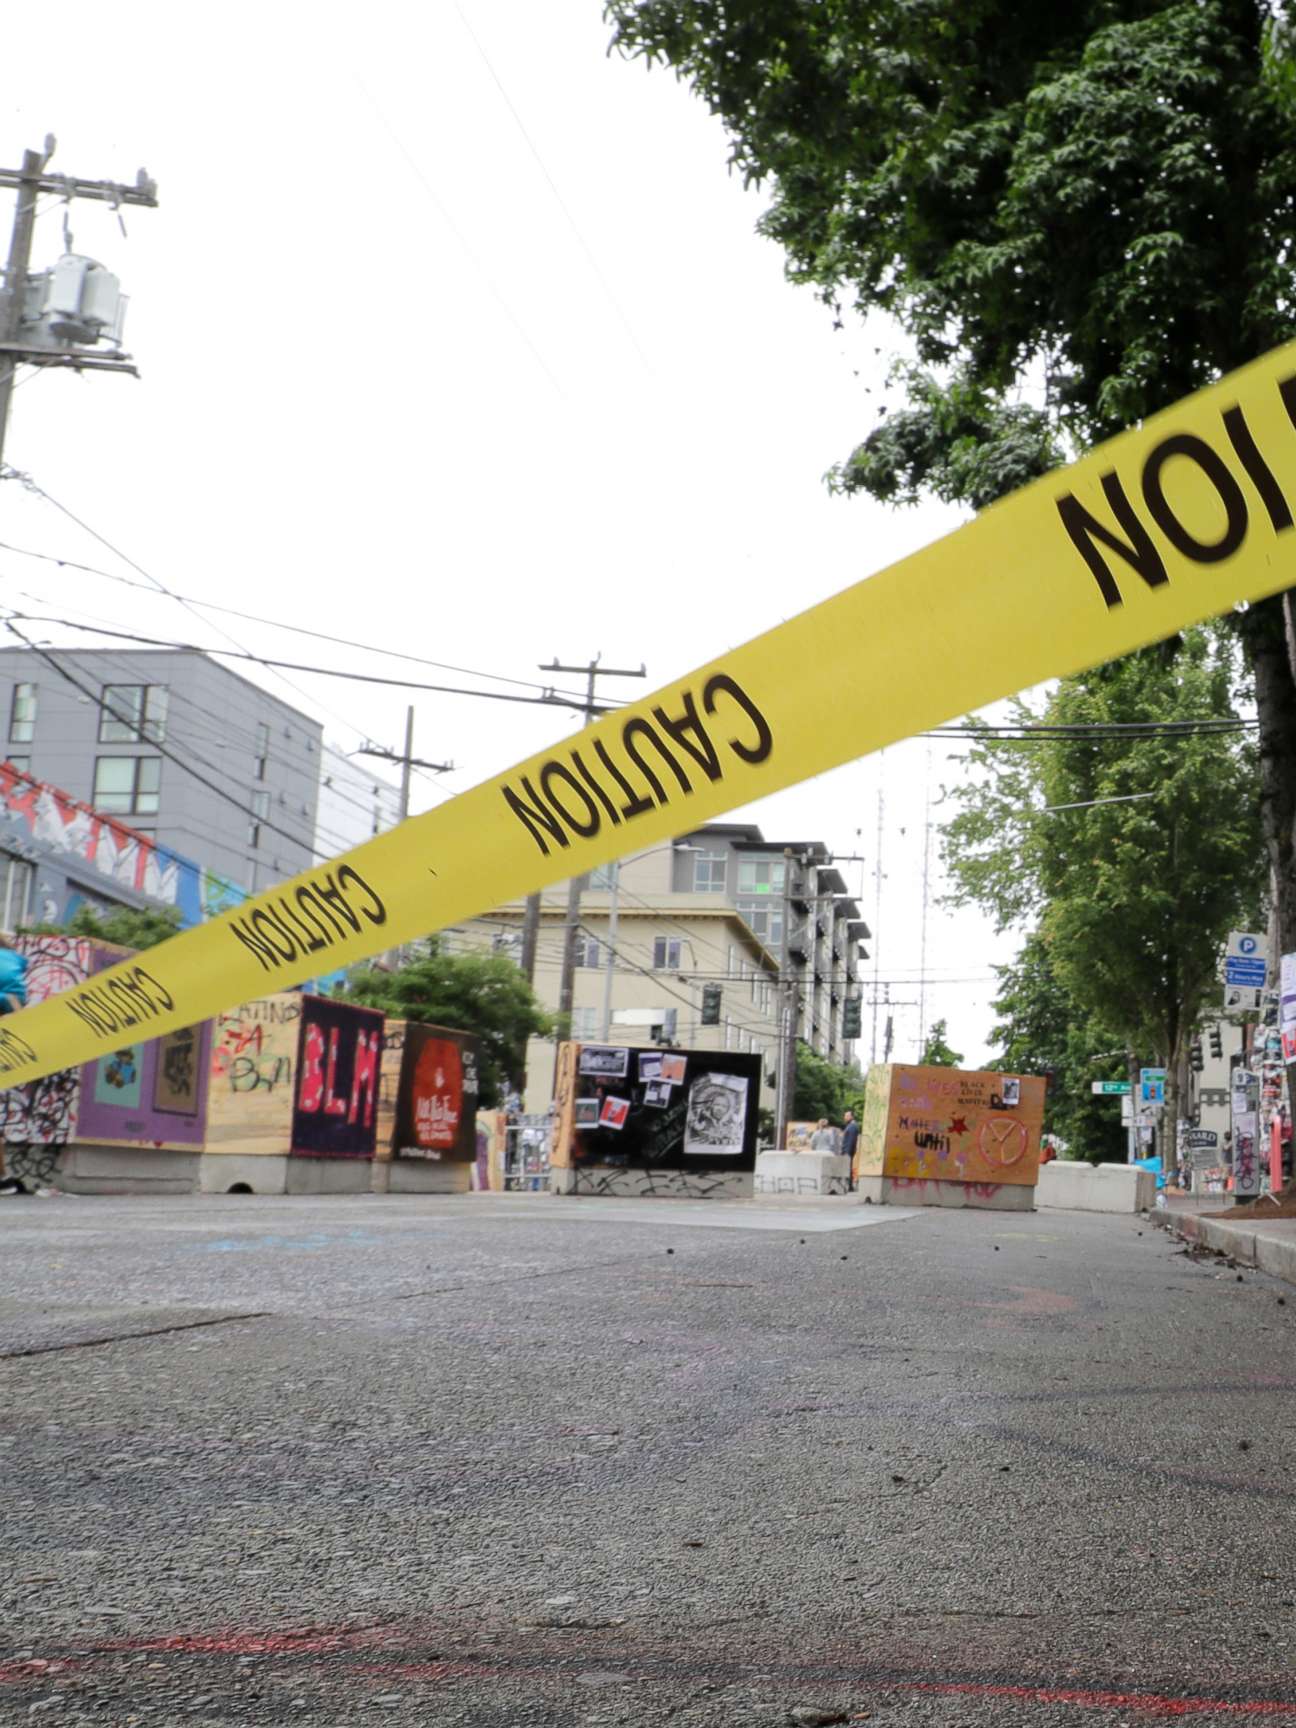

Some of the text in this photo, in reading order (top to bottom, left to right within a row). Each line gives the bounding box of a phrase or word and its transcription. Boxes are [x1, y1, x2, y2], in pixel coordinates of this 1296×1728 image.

[500, 673, 773, 857] CAUTION
[229, 864, 387, 971] CAUTION
[65, 966, 175, 1040] CAUTION
[299, 1022, 379, 1128] BLM
